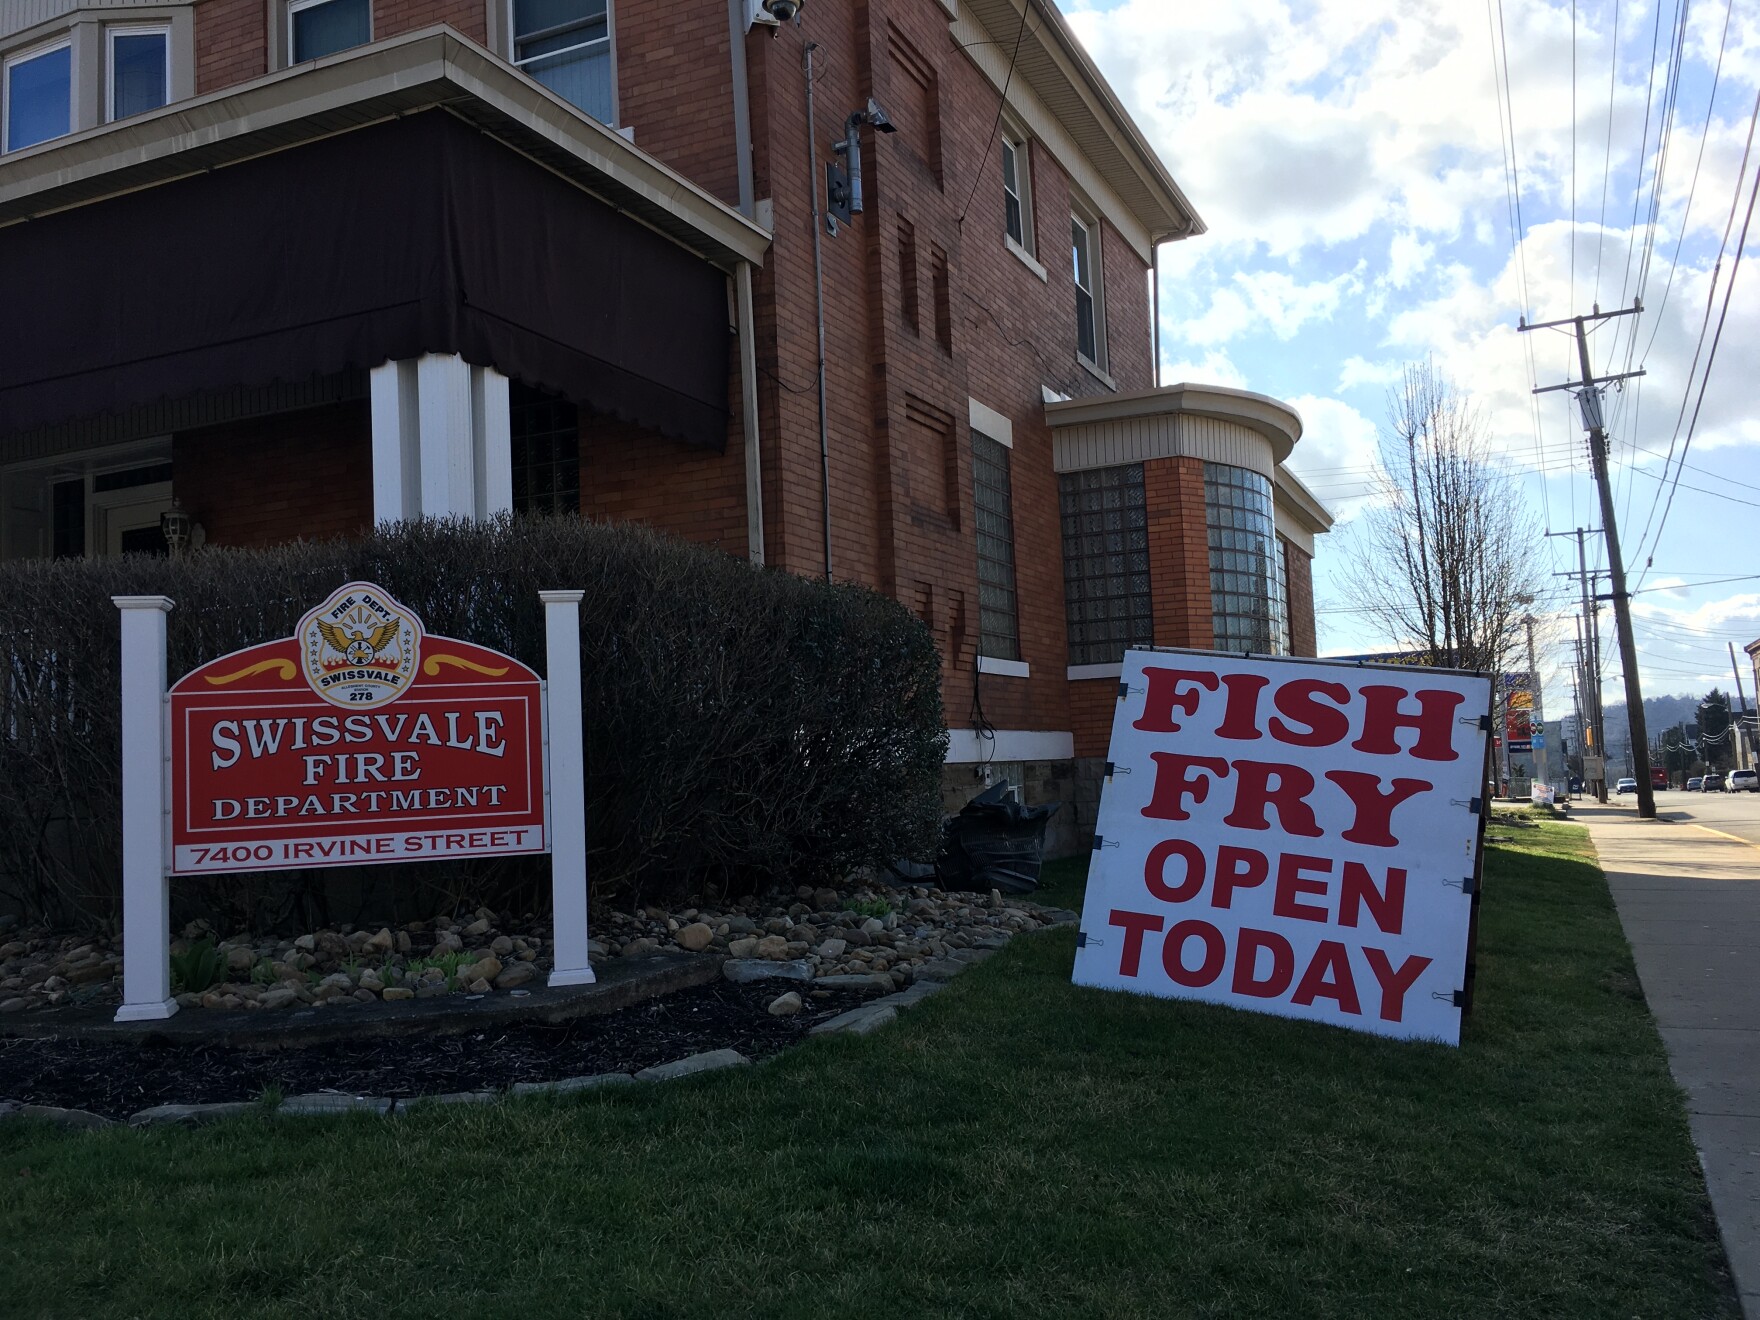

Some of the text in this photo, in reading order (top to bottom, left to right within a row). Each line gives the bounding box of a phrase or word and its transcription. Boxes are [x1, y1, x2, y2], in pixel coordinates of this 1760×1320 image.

[331, 594, 391, 622] FIRE DEPT.
[320, 670, 400, 687] SWISSVALE
[349, 692, 373, 702] 278
[1132, 666, 1466, 762] FISH
[211, 710, 507, 771] SWISSVALE
[302, 750, 422, 786] FIRE
[211, 784, 507, 821] DEPARTMENT
[1140, 751, 1434, 848] FRY
[189, 829, 529, 865] 7400 IRVINE STREET
[1144, 838, 1408, 936] OPEN
[1108, 908, 1434, 1023] TODAY
